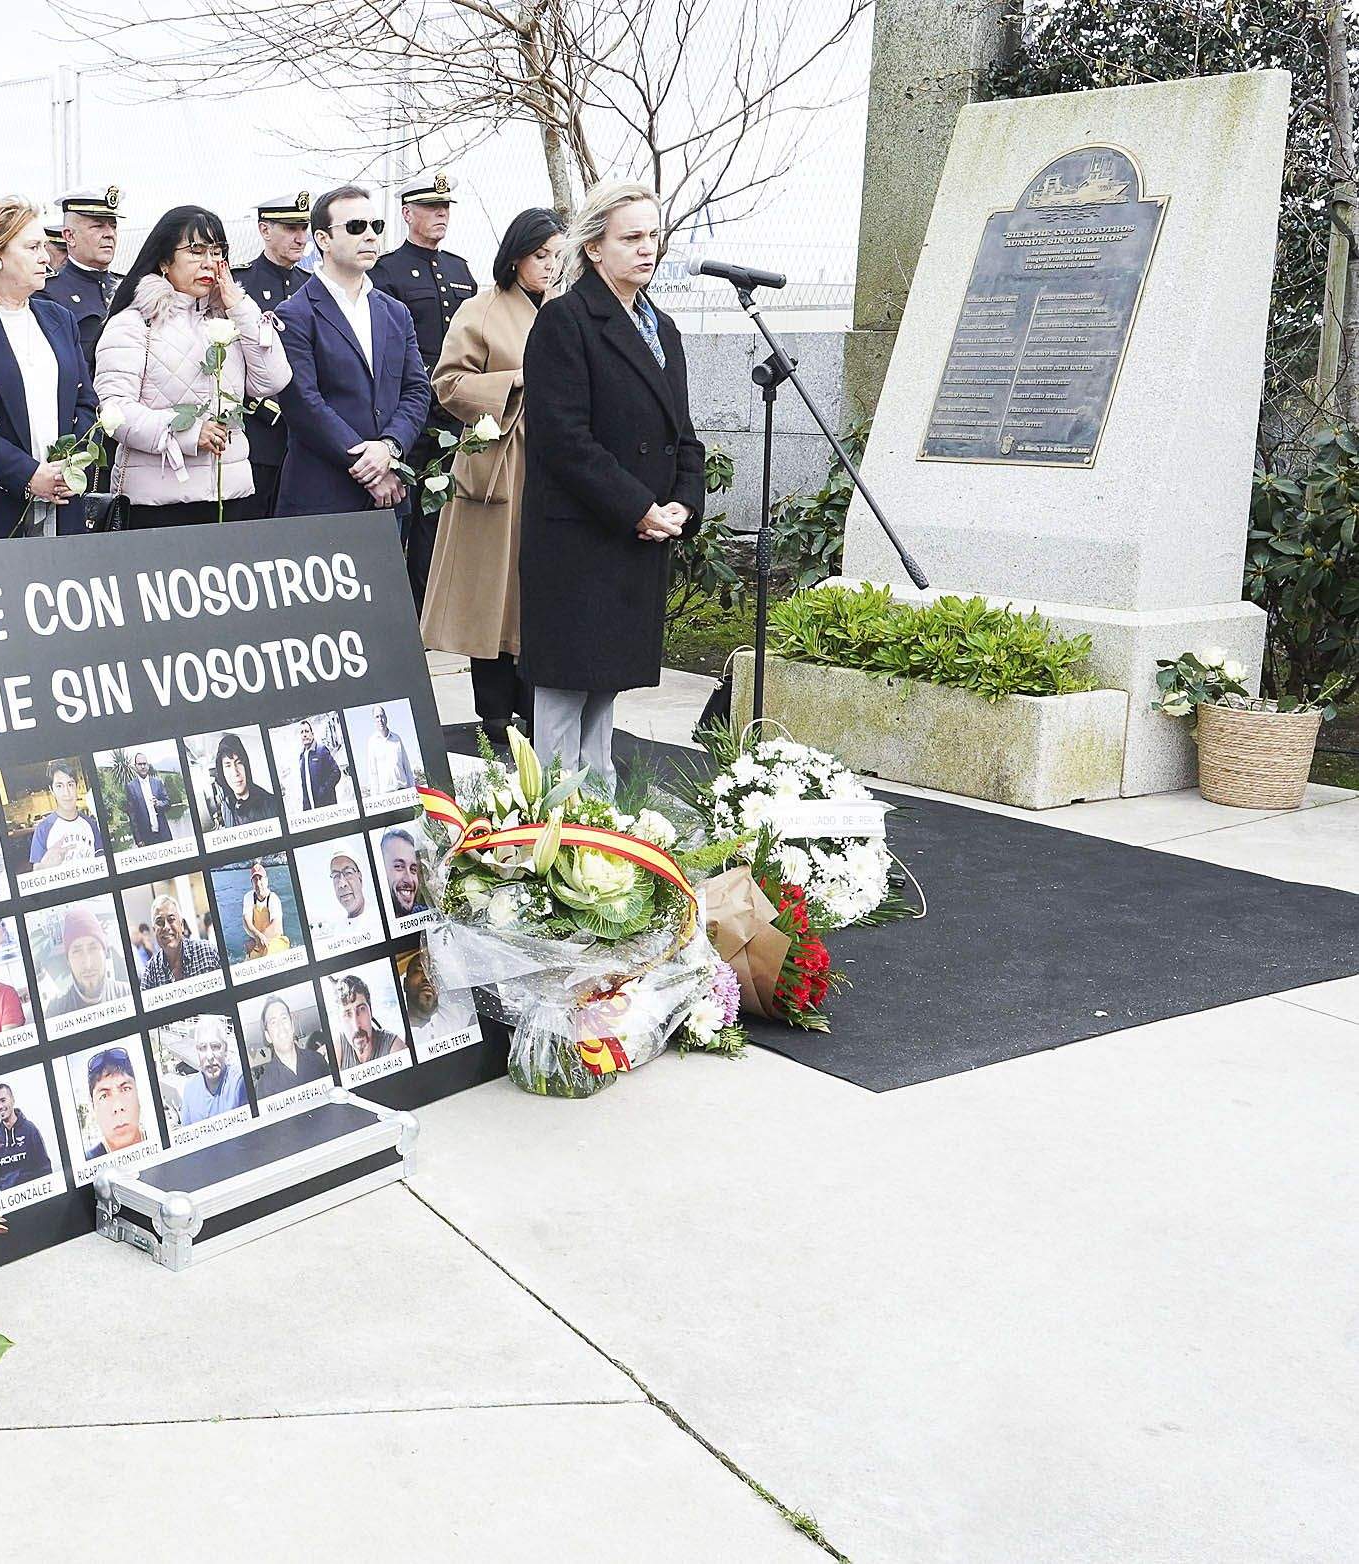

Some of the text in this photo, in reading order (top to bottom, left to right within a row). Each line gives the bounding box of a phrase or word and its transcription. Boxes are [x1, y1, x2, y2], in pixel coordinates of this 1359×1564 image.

[24, 575, 125, 636] CON
[136, 552, 372, 623] NOSOTROS,
[51, 661, 133, 723] SIN
[142, 630, 369, 707] VOSOTROS
[364, 795, 400, 813] FRANCISCO
[402, 793, 410, 803] DE
[291, 813, 324, 827] FERNANDO
[843, 815, 853, 825] DE
[212, 825, 274, 846] EDWIN CORDOVA
[121, 851, 157, 866] FERNANDO
[20, 862, 105, 890] DIEGO ANDRES MORE
[400, 918, 419, 931] PEDRO
[234, 965, 257, 977] MIGUEL
[147, 976, 223, 1008] JUAN ANTONIO CORDERO
[55, 1020, 75, 1033] JUAN
[428, 1033, 471, 1055] MICHEL TETEH
[350, 1057, 403, 1083] RICARDO ARIAS
[266, 1096, 296, 1113] WILLIAM
[200, 1120, 223, 1136] FRANCO
[141, 1143, 159, 1159] CRUZ
